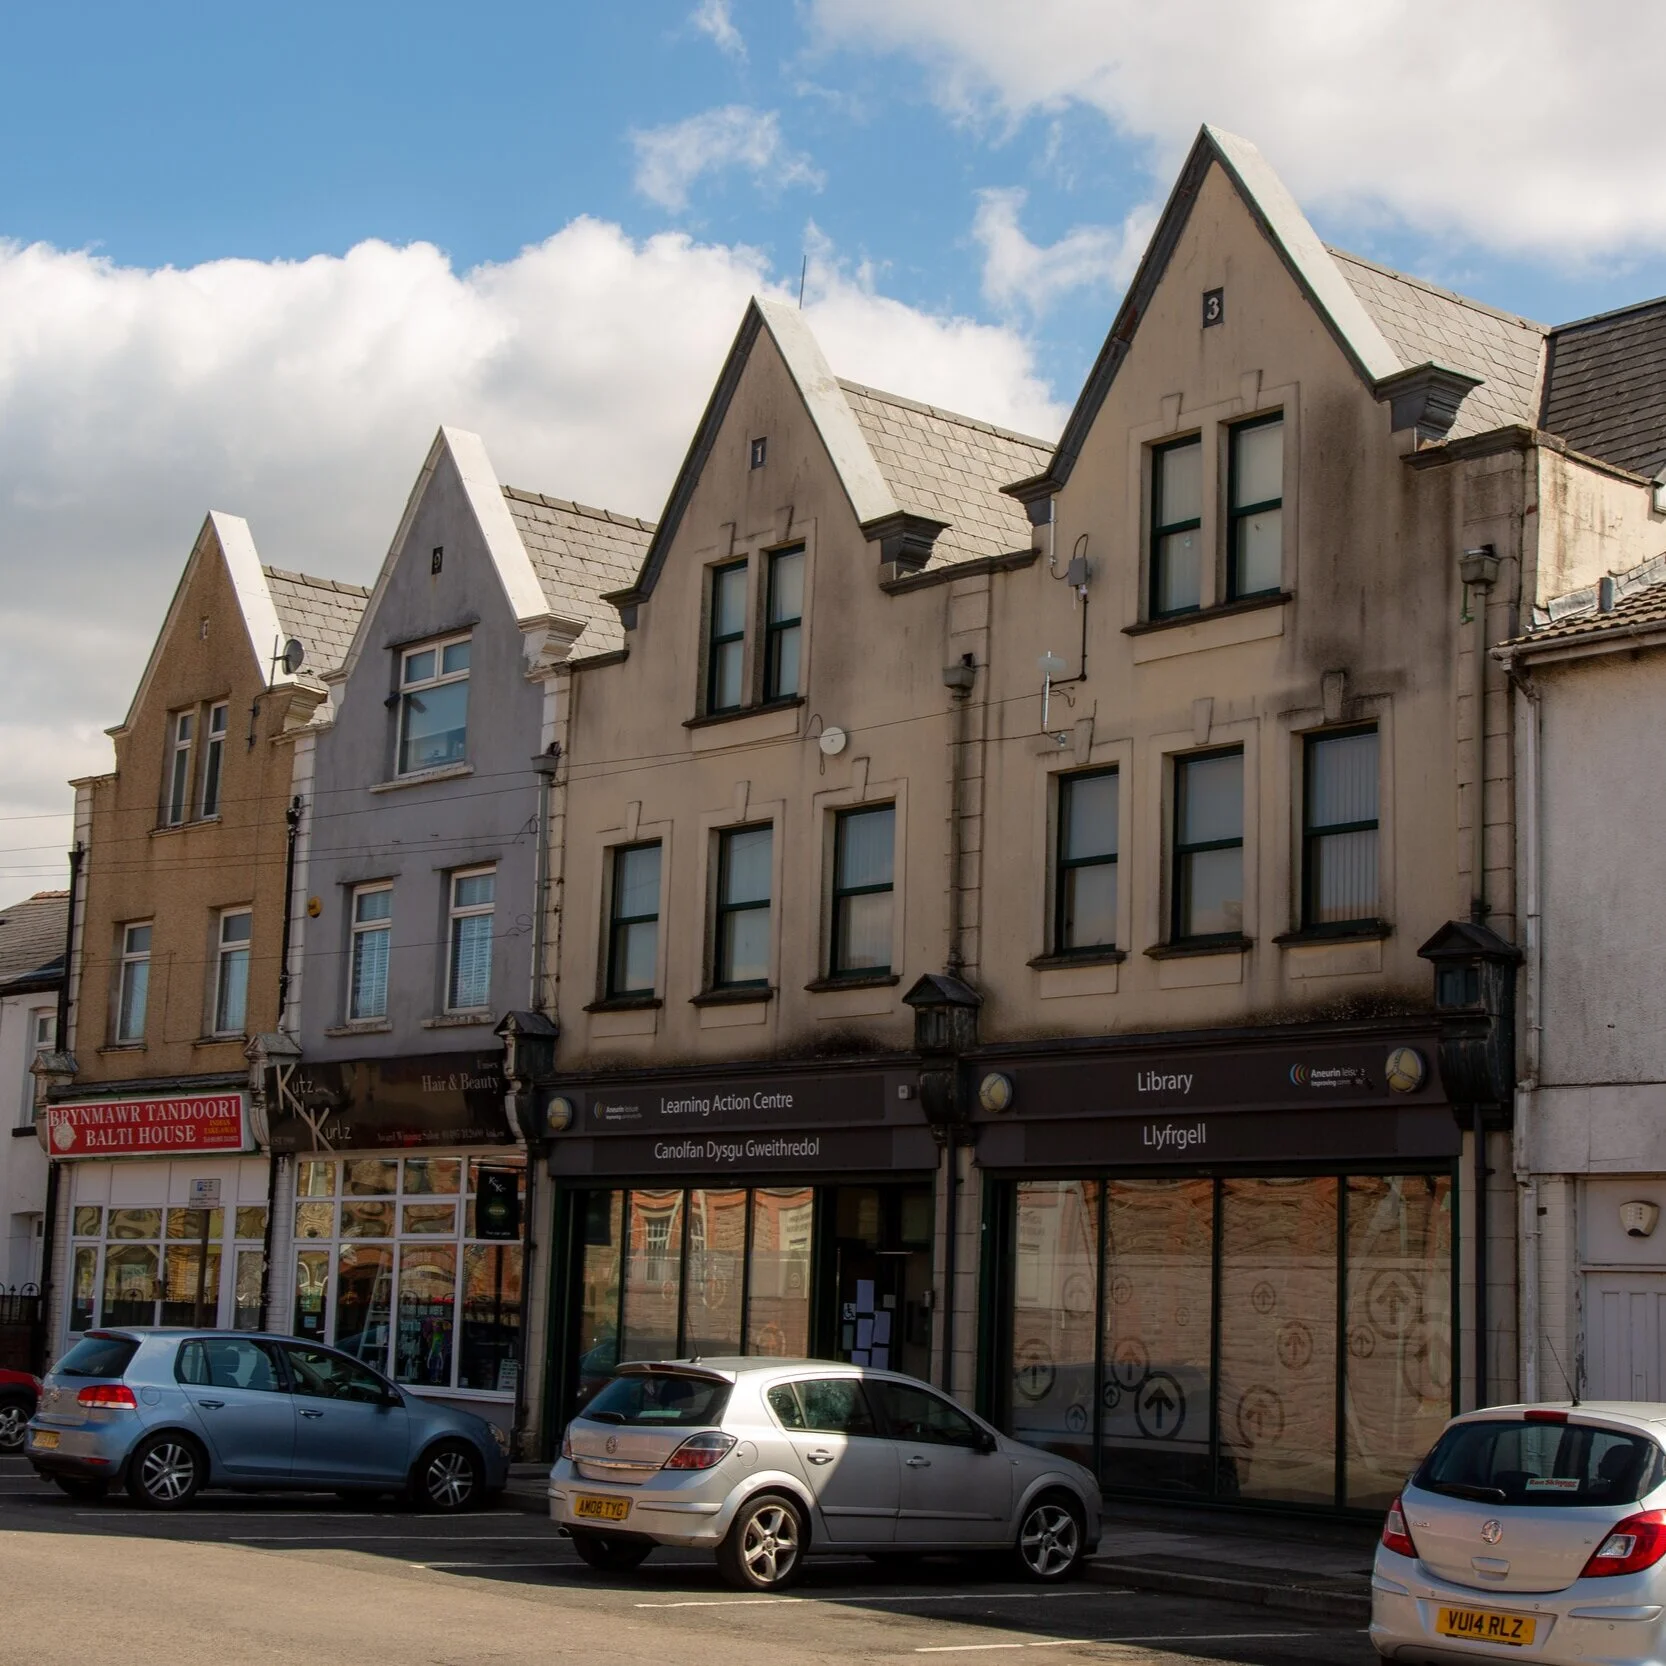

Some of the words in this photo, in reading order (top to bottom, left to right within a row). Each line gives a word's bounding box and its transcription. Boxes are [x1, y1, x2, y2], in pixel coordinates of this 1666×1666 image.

[1207, 297, 1220, 320] 3
[756, 445, 762, 463] 1
[421, 1075, 446, 1092] Hair
[448, 1073, 458, 1090] &
[460, 1072, 500, 1094] Beauty
[1137, 1070, 1193, 1094] Library
[1311, 1067, 1341, 1078] Aneurin
[1342, 1067, 1365, 1077] leise
[276, 1062, 313, 1112] Kutz
[50, 1105, 141, 1127] BRYNMAWR
[146, 1100, 237, 1120] TANDOORI
[660, 1097, 710, 1116] Learning
[712, 1094, 750, 1112] Action
[753, 1092, 794, 1109] Centre
[86, 1127, 133, 1147] BALTI
[139, 1125, 197, 1144] HOUSE
[1144, 1122, 1206, 1150] Llyfrgell
[654, 1141, 704, 1159] Canolfan
[706, 1141, 743, 1162] Dysgu
[745, 1137, 820, 1157] Gweithredol
[579, 1500, 602, 1514] AM08
[605, 1502, 624, 1516] TYG
[1449, 1611, 1484, 1633] VU14
[1489, 1616, 1523, 1638] RLZ
